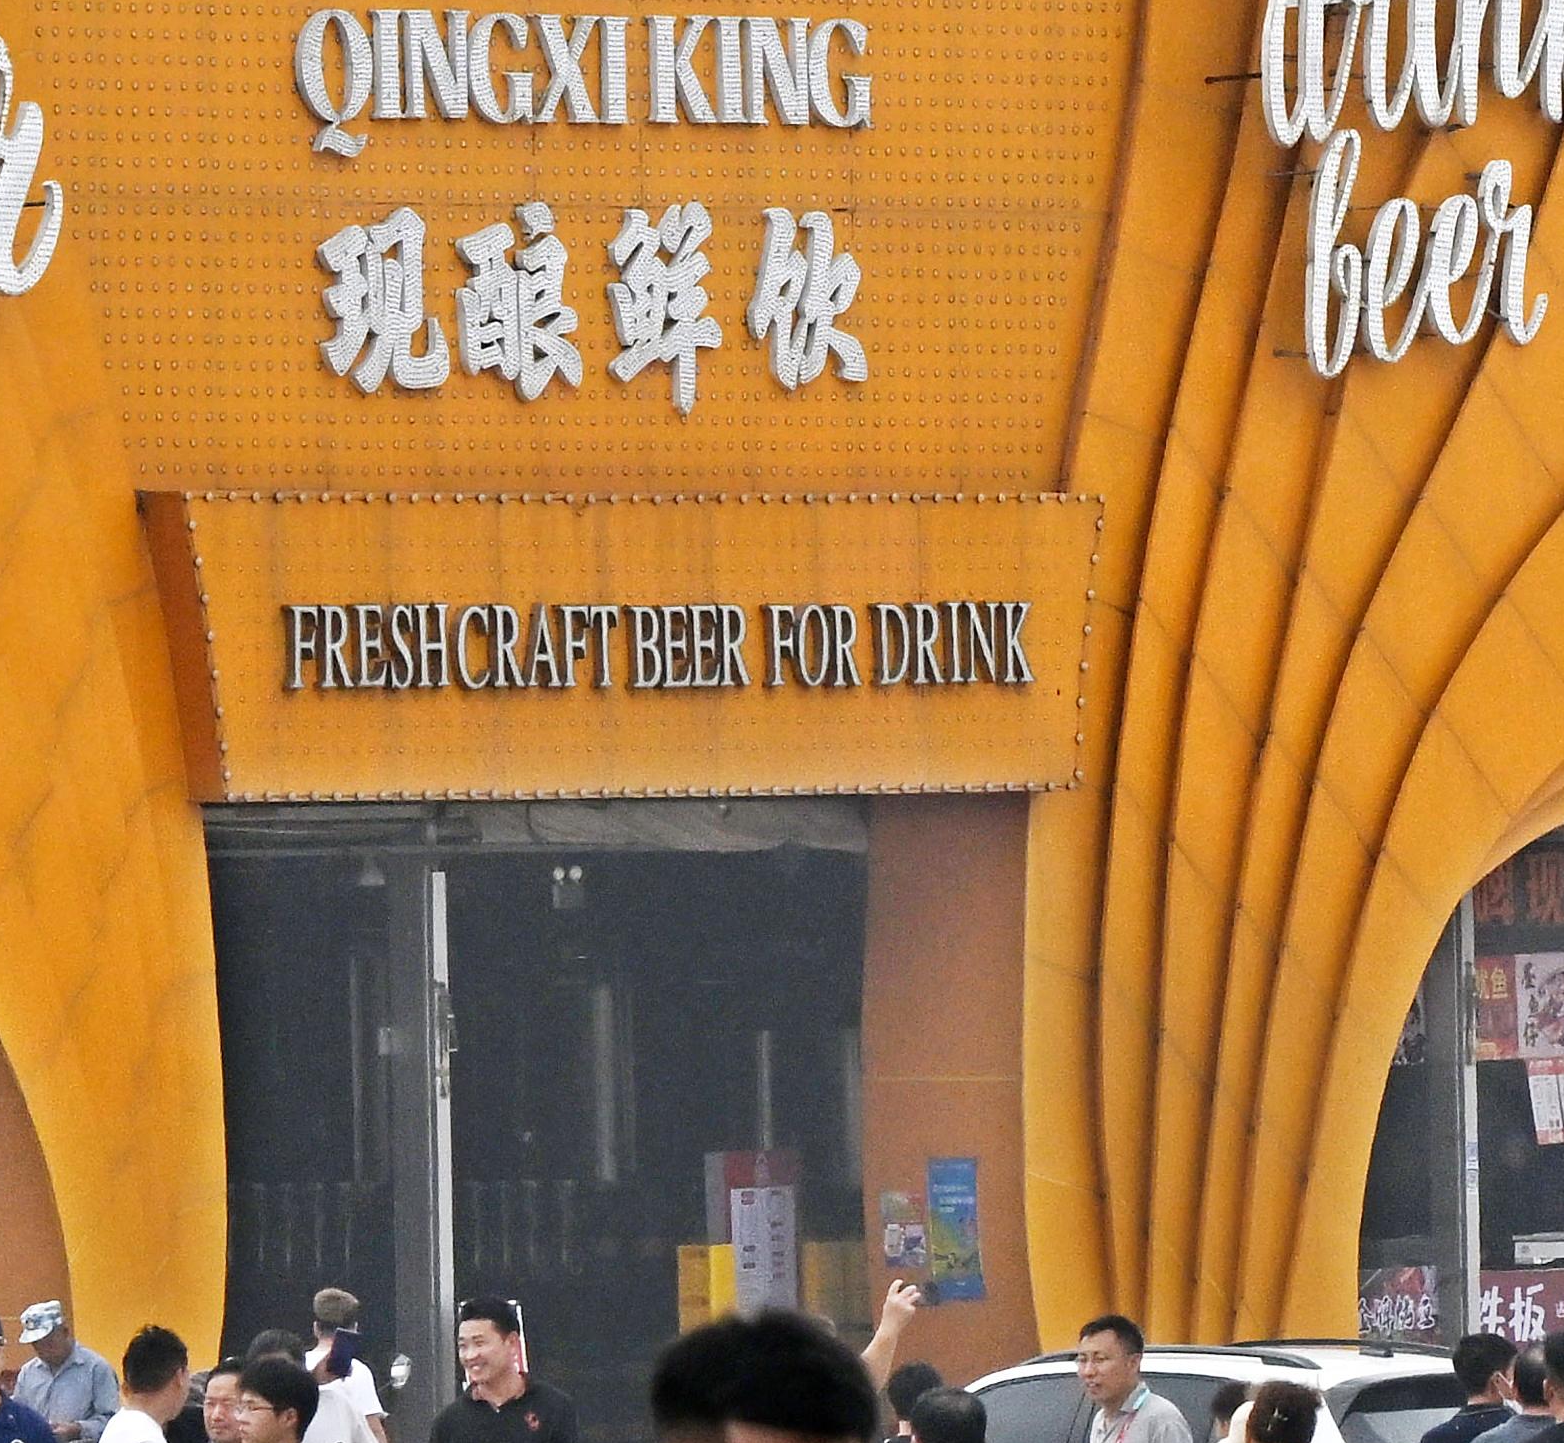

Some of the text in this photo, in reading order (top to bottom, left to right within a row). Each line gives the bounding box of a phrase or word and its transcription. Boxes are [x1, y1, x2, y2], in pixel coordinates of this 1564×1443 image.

[295, 8, 871, 157] QINGXI KING
[319, 201, 868, 416] 现酿鲜饮
[1304, 128, 1548, 380] beer
[283, 601, 1035, 690] FRESH CRAFT BEER FOR DRINK
